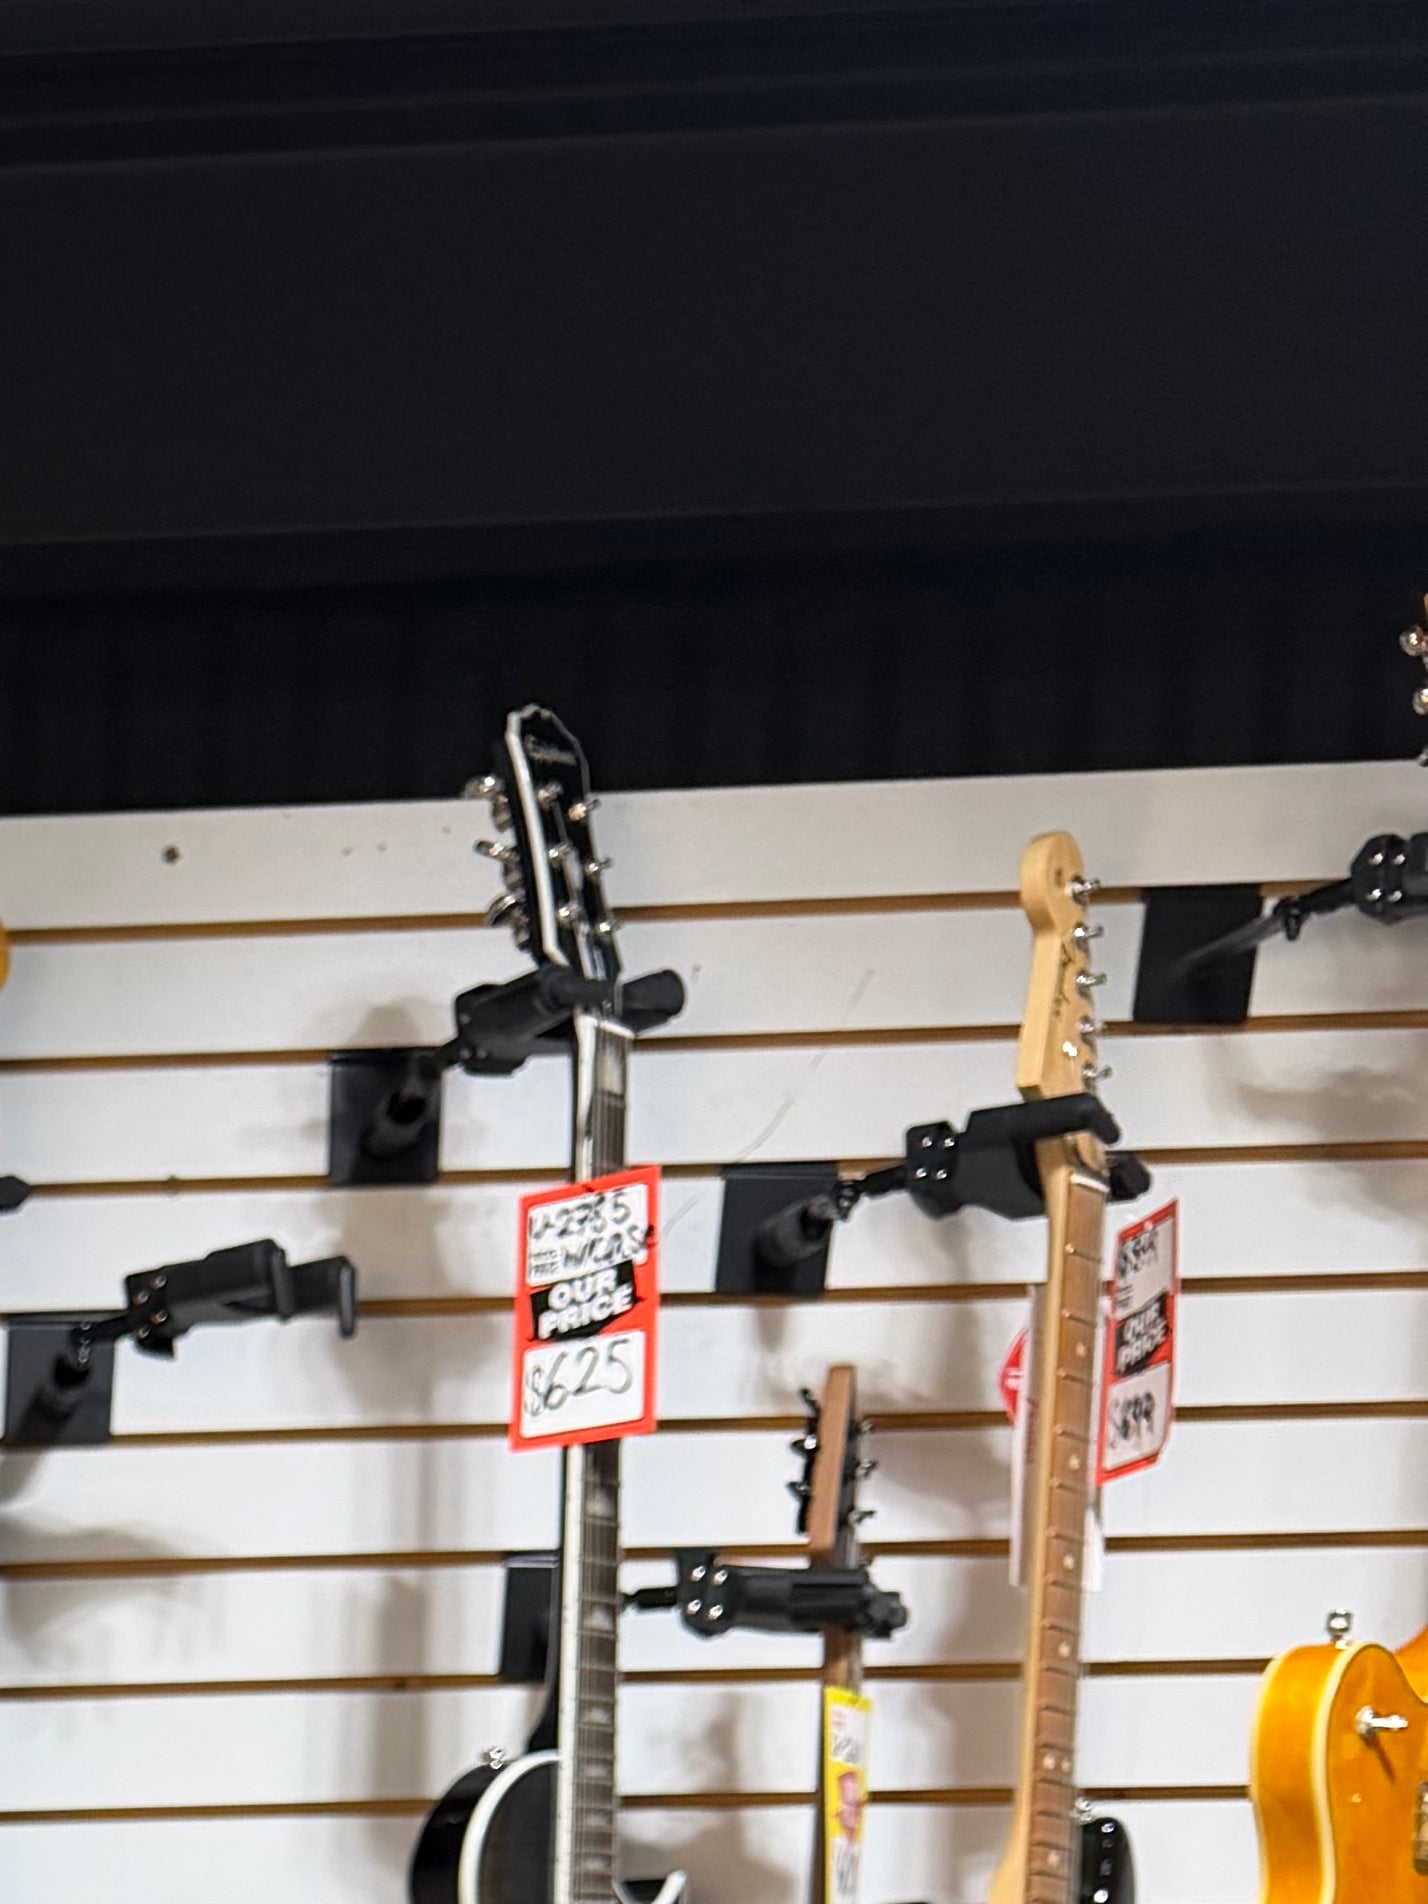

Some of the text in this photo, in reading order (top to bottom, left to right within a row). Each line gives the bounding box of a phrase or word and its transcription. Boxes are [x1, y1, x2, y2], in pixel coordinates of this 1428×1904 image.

[538, 1287, 634, 1341] PRICE
[547, 1268, 619, 1310] OUR
[1116, 1321, 1169, 1375] PRICE
[525, 1338, 633, 1418] $625
